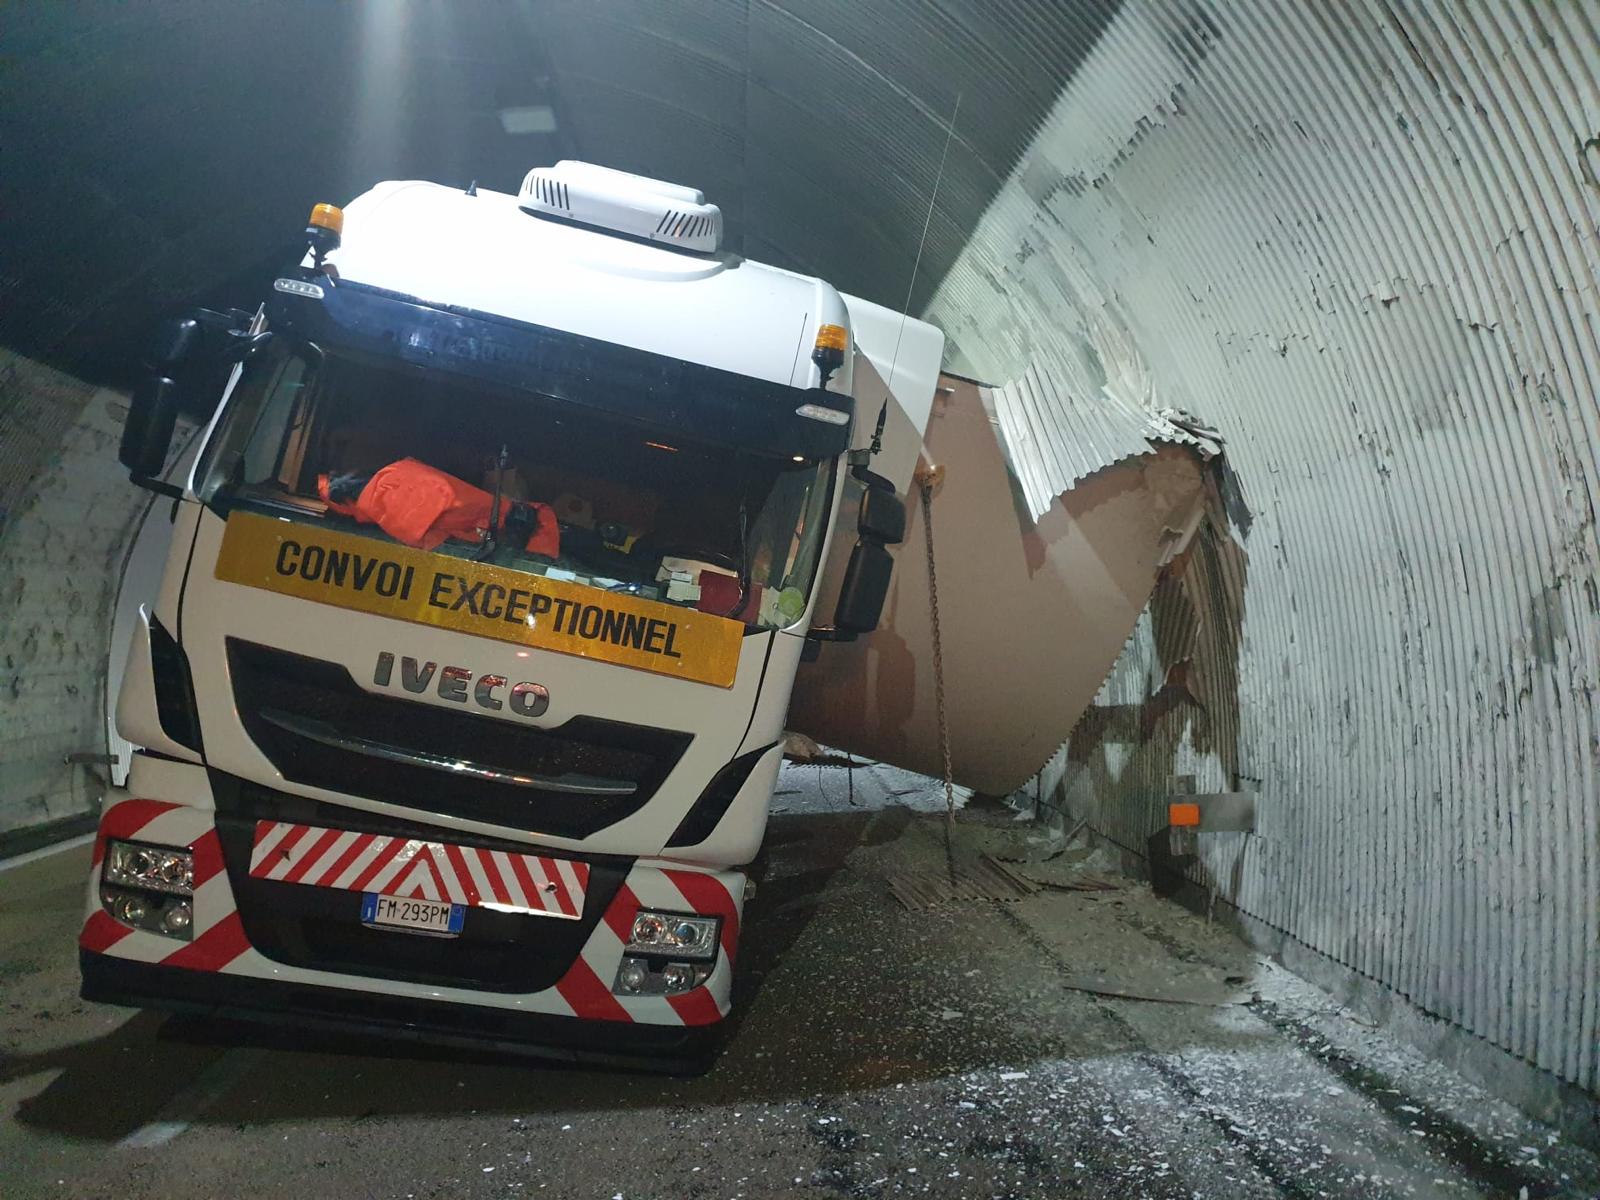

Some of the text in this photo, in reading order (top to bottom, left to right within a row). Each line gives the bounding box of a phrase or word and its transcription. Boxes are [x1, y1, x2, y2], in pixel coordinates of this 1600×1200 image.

[275, 540, 682, 659] CONVOI EXCEPTIONNEL
[373, 651, 551, 718] IVECO
